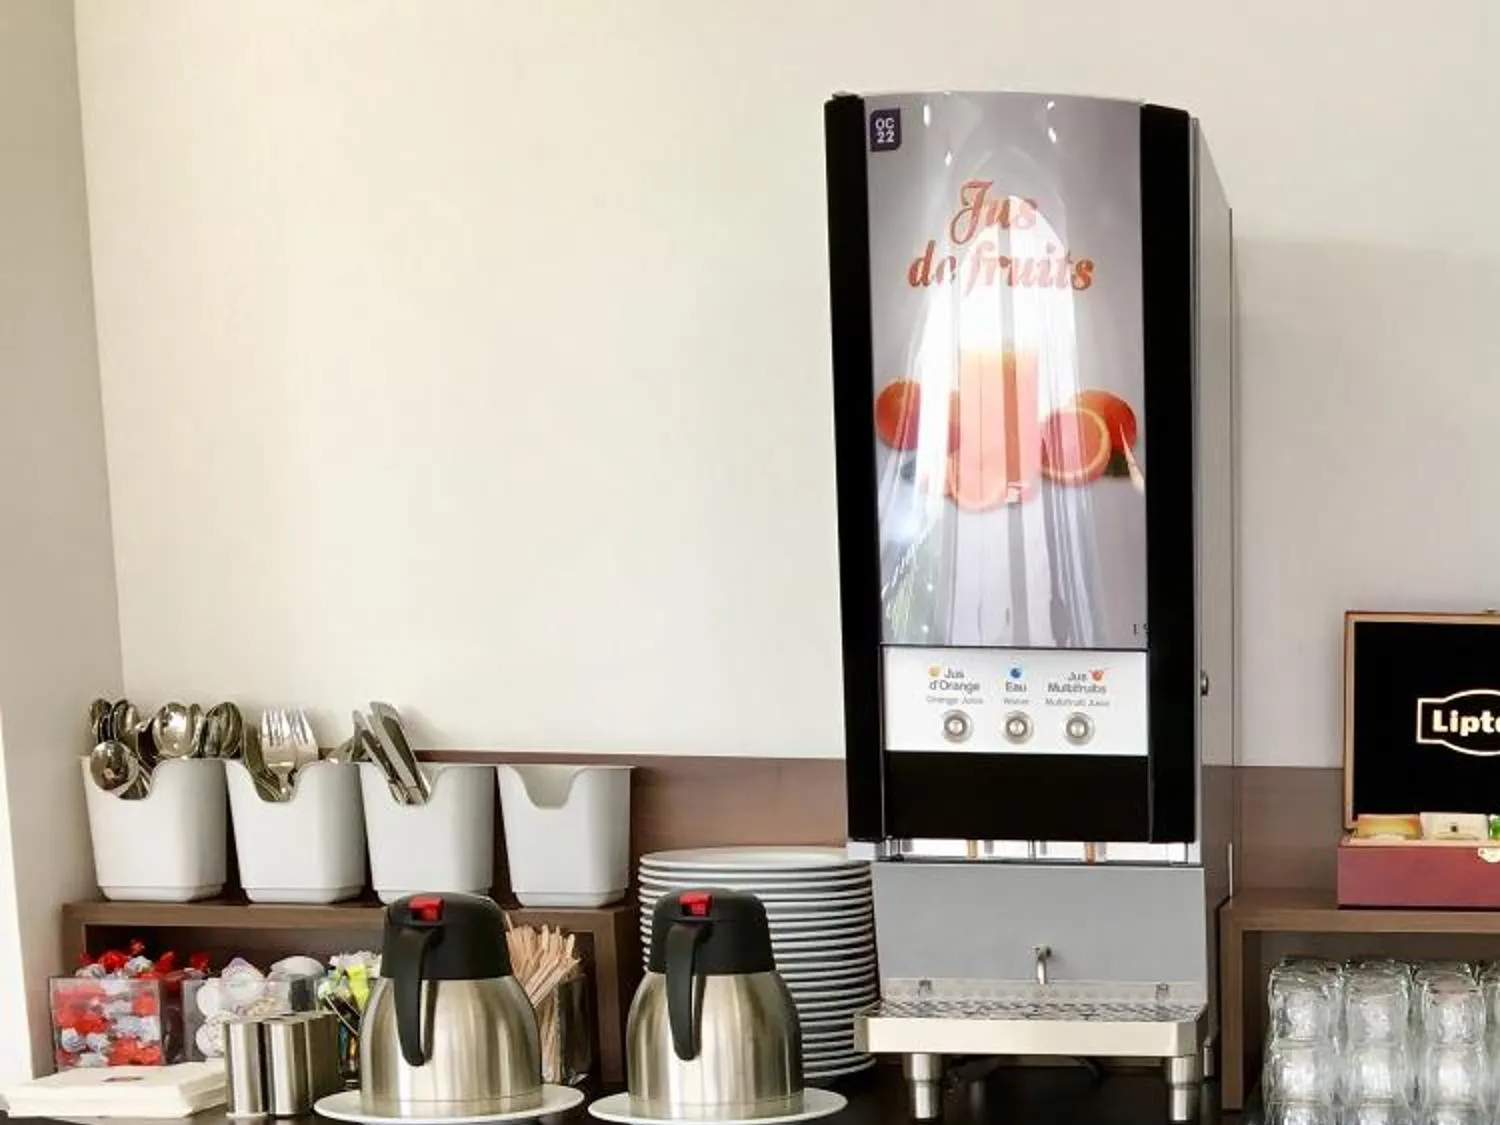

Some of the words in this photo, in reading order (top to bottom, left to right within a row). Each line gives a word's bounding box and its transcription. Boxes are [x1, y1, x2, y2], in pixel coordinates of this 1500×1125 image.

[876, 130, 895, 144] 22
[951, 179, 1038, 245] Jus
[963, 240, 1095, 298] fruits
[944, 667, 964, 679] Jus
[1067, 671, 1087, 681] Jus
[929, 680, 980, 695] d'Orange
[1005, 682, 1027, 693] Eau
